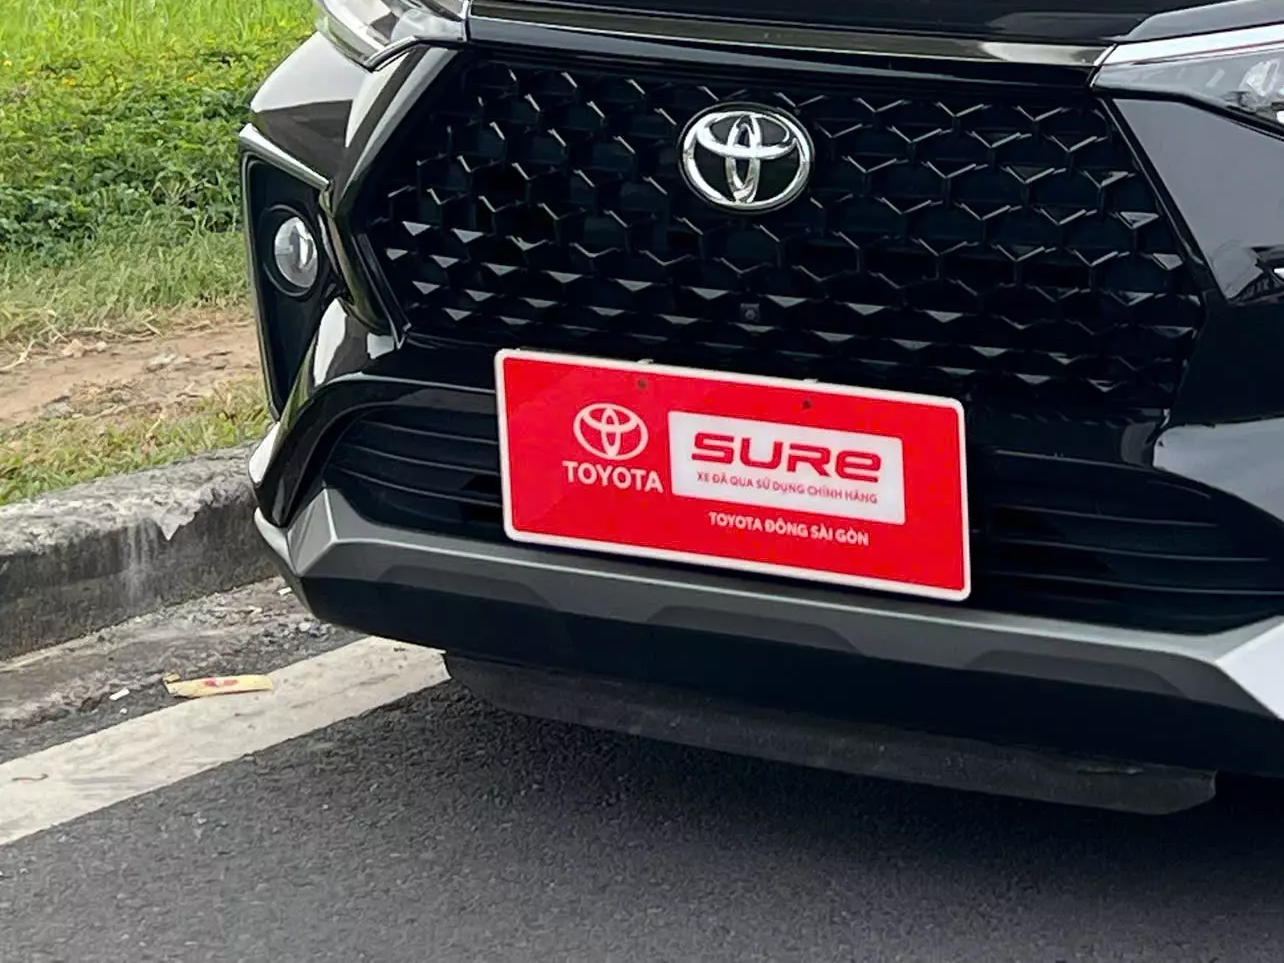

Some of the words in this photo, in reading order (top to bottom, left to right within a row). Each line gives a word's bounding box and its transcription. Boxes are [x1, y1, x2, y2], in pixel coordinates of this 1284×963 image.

[562, 460, 664, 494] TOYOTA
[697, 472, 709, 483] XE
[730, 476, 753, 488] QUA
[708, 511, 763, 532] TOYOTA
[765, 517, 809, 538] ĐÔNG
[810, 523, 834, 542] SÀI
[836, 525, 869, 546] GÒN
